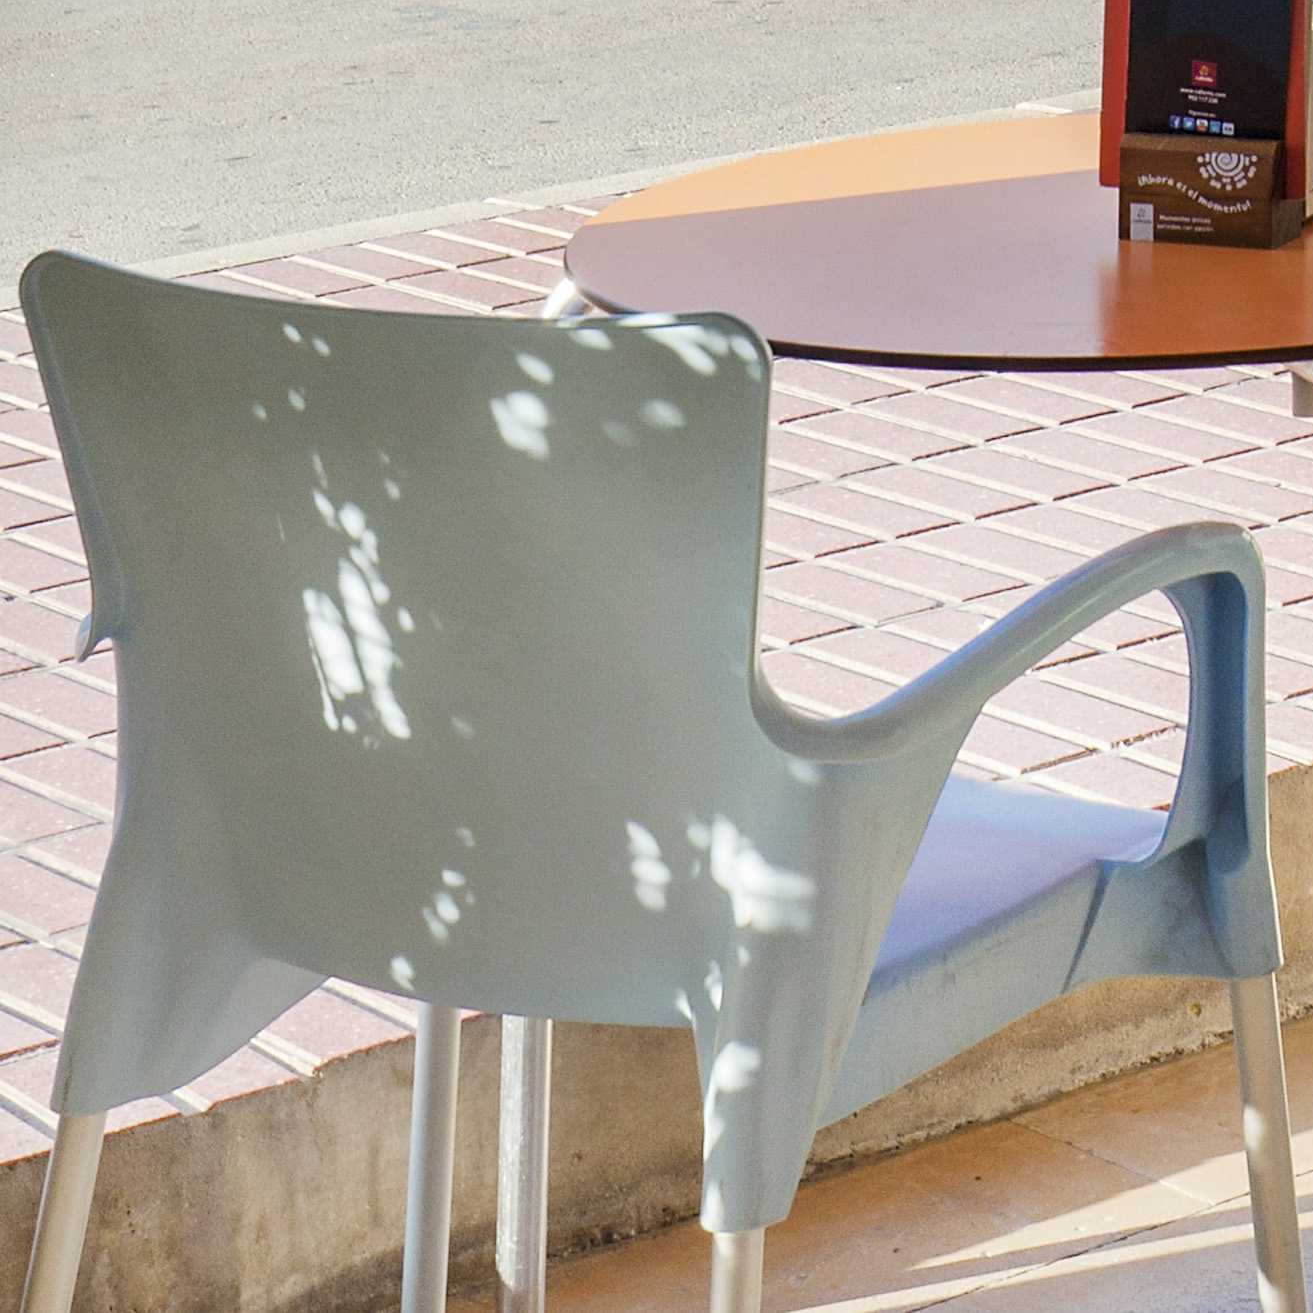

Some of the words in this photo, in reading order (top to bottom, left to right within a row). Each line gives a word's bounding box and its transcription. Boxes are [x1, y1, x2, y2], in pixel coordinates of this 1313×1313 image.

[1137, 174, 1174, 186] ¡Ahora
[1176, 181, 1187, 192] es
[1187, 189, 1199, 200] el
[1198, 195, 1252, 213] momento!
